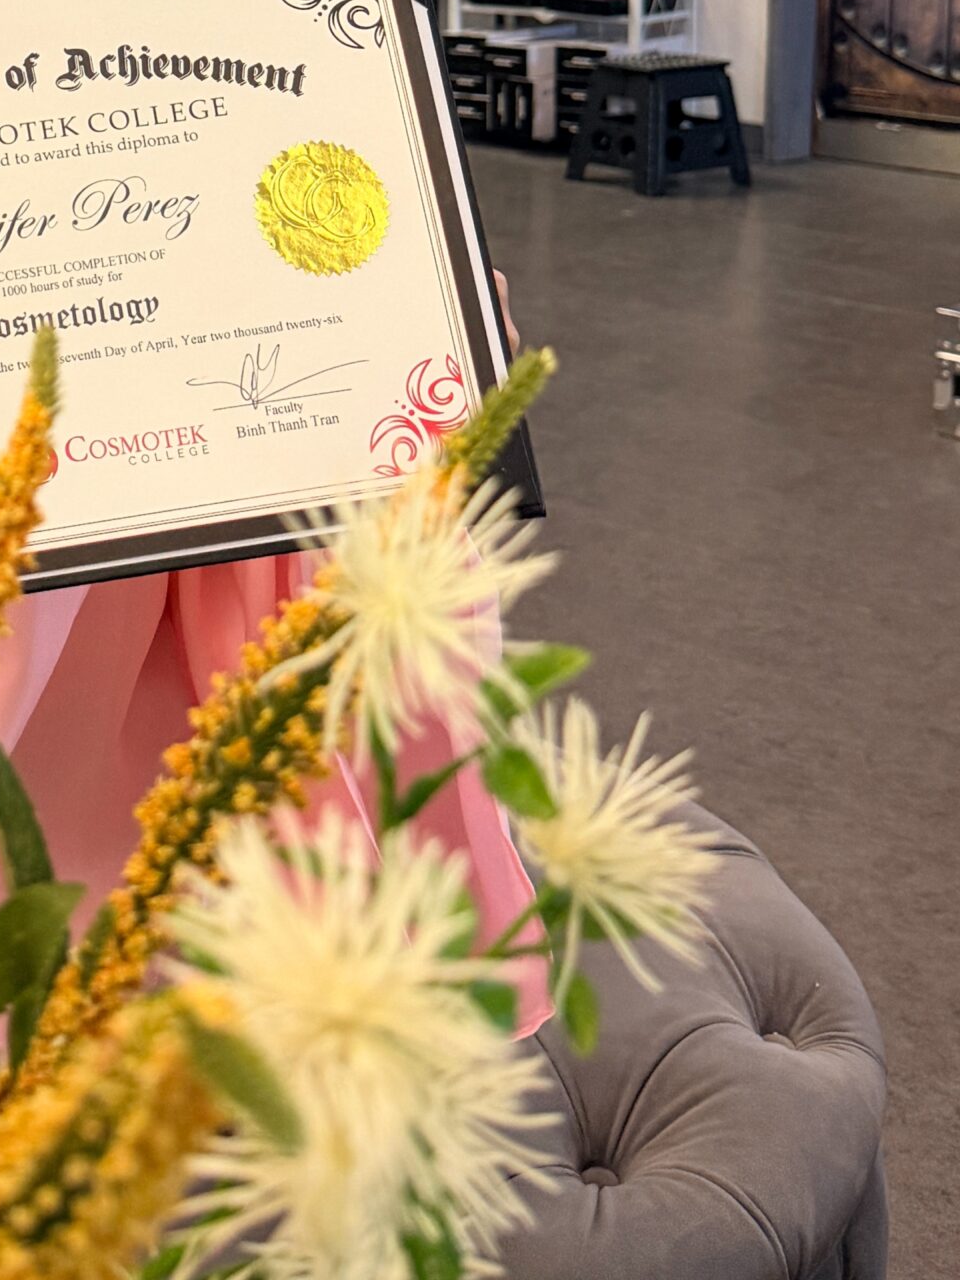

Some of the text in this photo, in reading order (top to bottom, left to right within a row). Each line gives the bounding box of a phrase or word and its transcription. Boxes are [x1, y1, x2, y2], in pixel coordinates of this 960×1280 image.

[5, 52, 40, 93] of
[55, 44, 308, 97] Achievement
[88, 96, 229, 133] COLLEGE
[15, 153, 30, 165] to
[34, 144, 81, 162] award
[86, 141, 113, 155] this
[117, 135, 180, 153] diploma
[183, 130, 199, 142] to
[72, 176, 200, 240] Perez
[63, 251, 147, 273] COMPLETION
[150, 248, 167, 260] OF
[1, 271, 123, 297] 1000 hours of study for
[17, 348, 101, 370] tw-seventh
[105, 345, 127, 357] Day
[131, 341, 143, 353] of
[146, 337, 178, 352] April,
[181, 334, 207, 346] Year
[210, 331, 231, 341] two
[234, 321, 283, 338] thousand
[286, 313, 343, 330] twenty-six
[236, 414, 340, 439] Binh Thanh Tran
[264, 402, 303, 416] Faculty
[64, 424, 208, 462] COSMOTEK
[128, 444, 211, 466] COLLEGE
